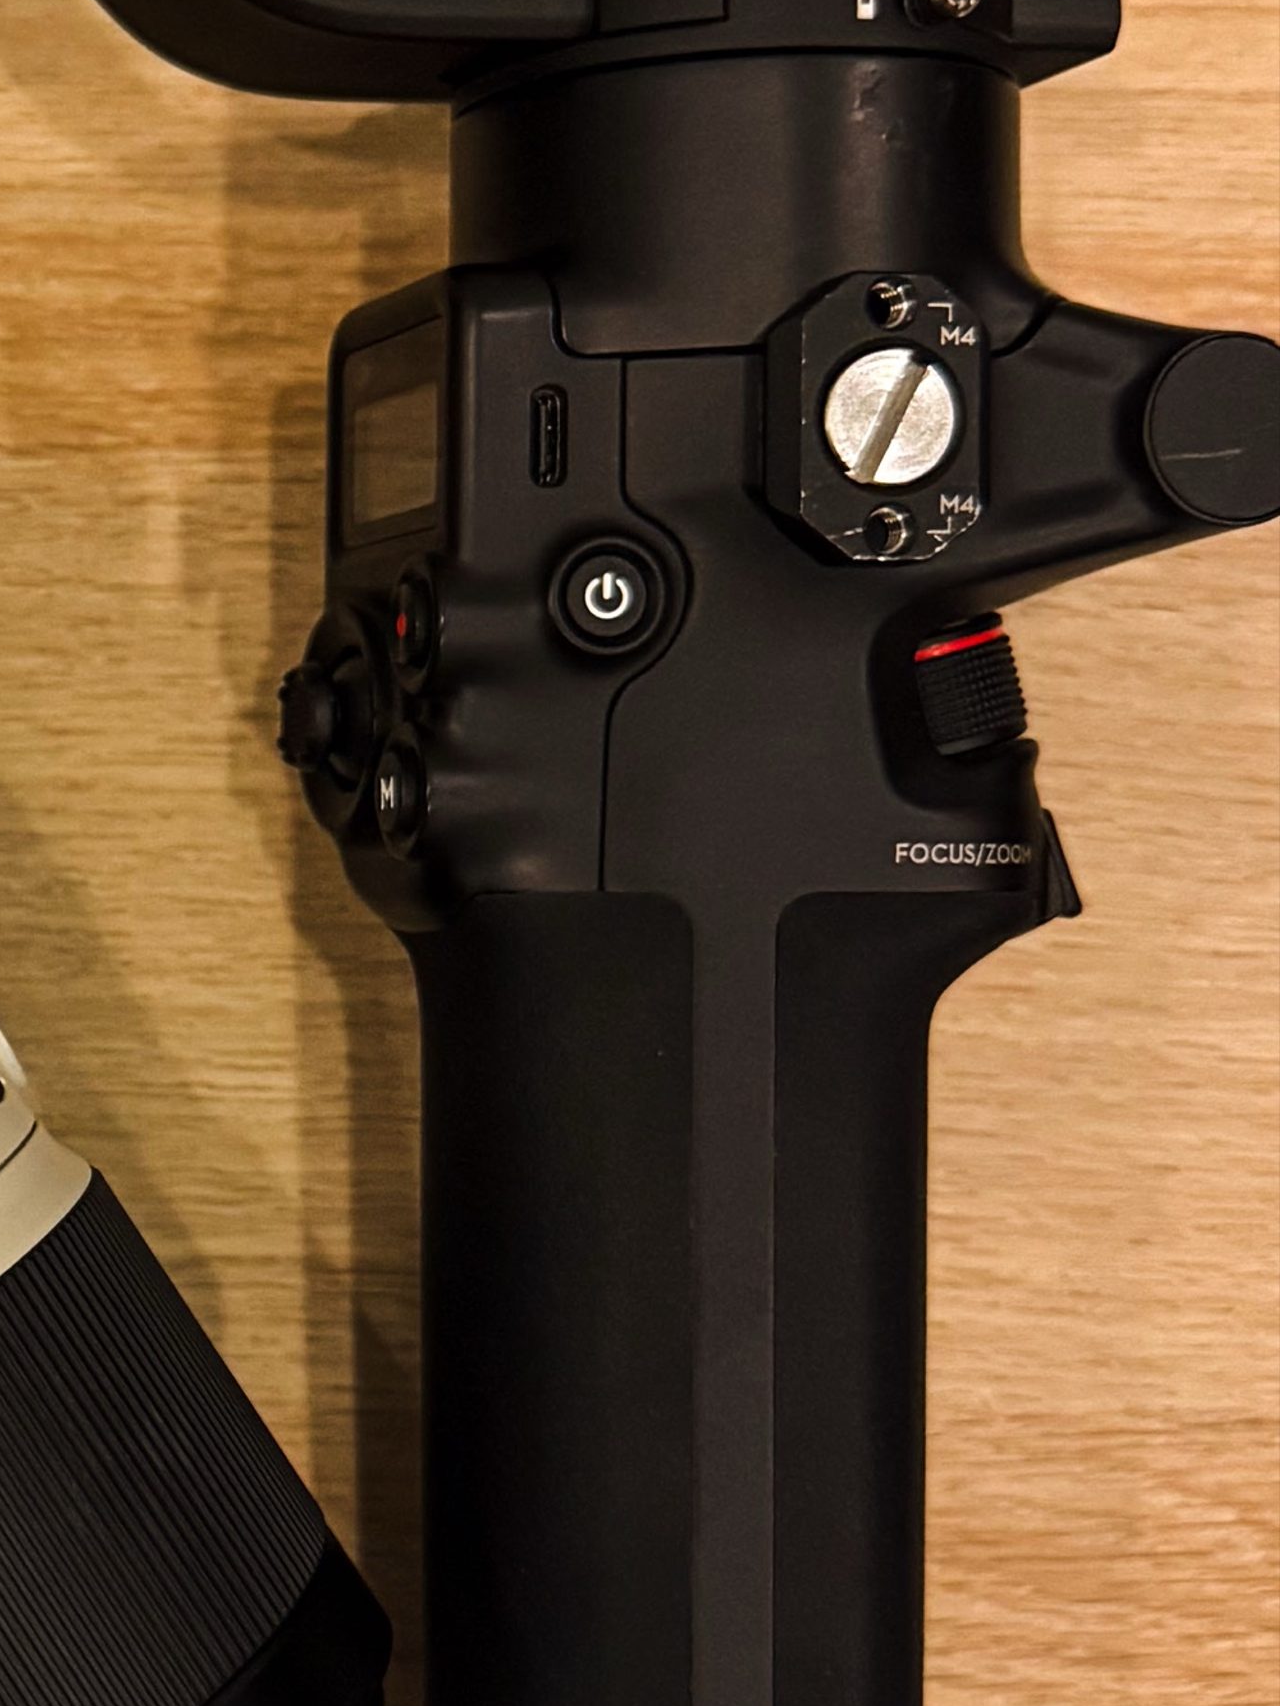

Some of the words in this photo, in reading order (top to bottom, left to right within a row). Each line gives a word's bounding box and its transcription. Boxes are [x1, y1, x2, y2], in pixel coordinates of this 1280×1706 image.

[940, 325, 977, 347] M4
[939, 493, 976, 516] M4
[895, 842, 1032, 866] FOCUS/ZOOM
